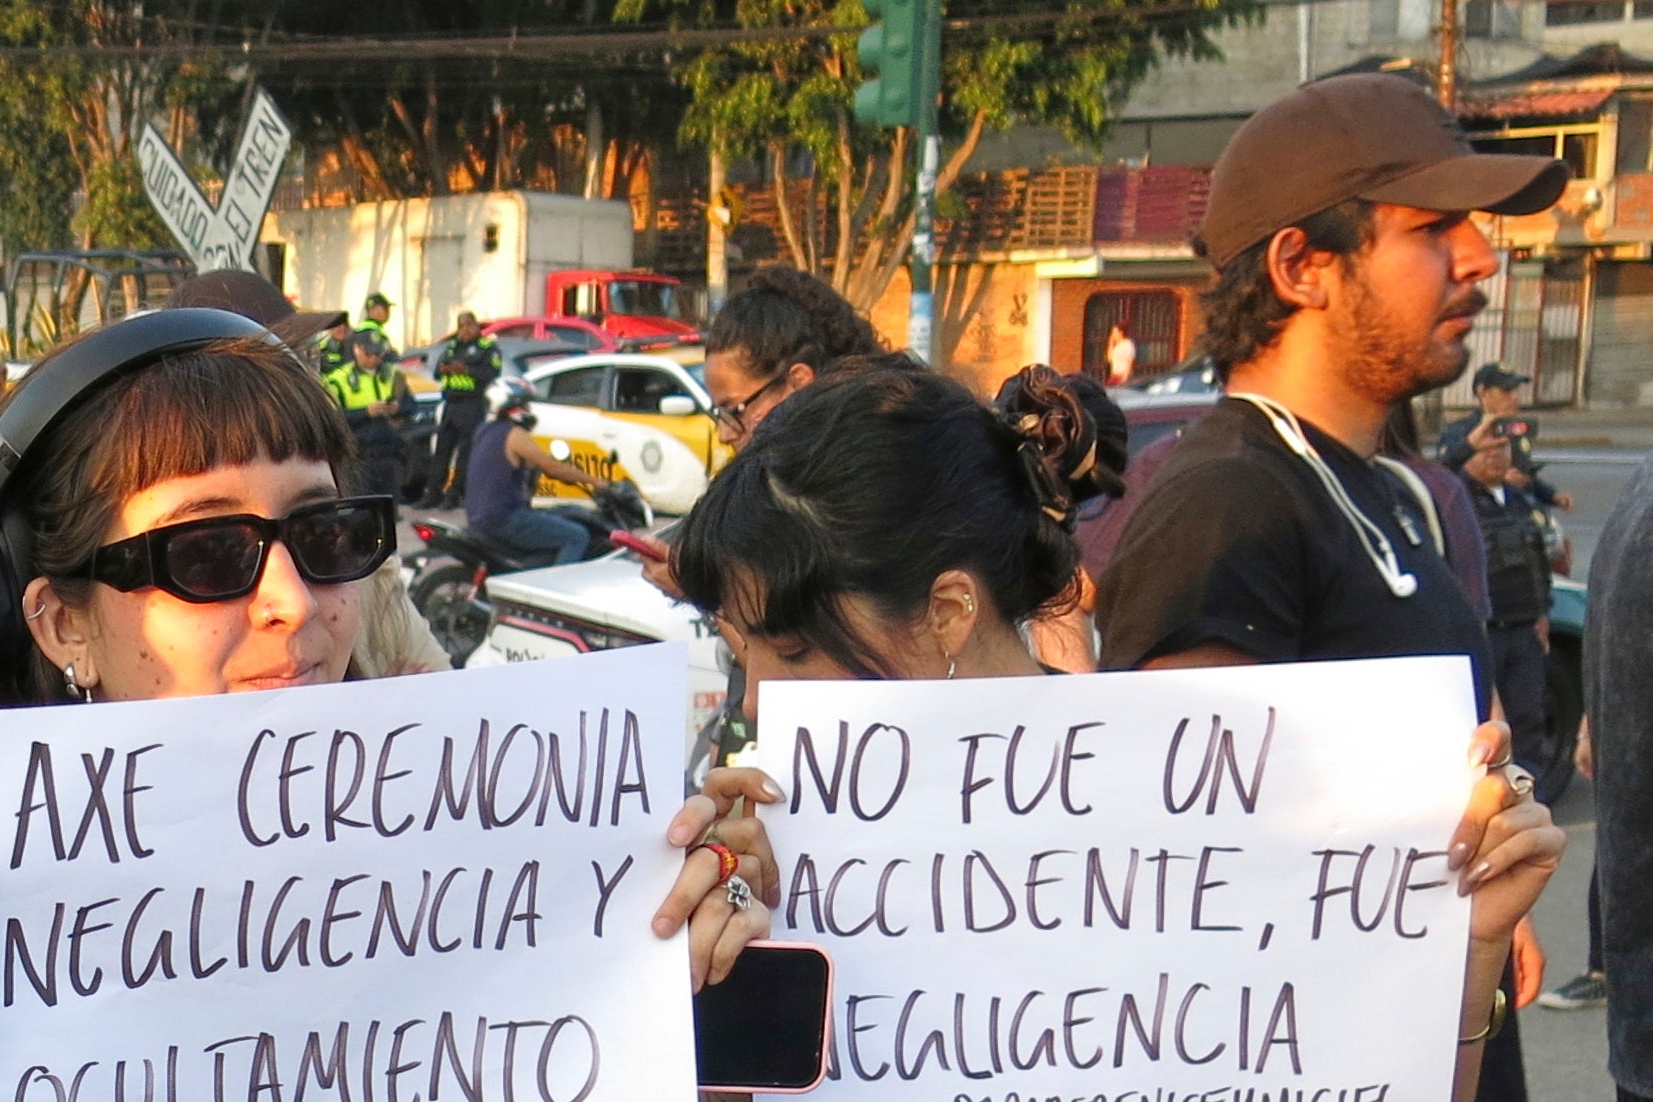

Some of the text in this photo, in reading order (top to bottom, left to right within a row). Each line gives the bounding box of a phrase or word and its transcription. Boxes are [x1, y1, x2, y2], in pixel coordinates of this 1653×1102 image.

[142, 137, 209, 250] CUIDADO
[237, 106, 284, 198] TREN
[9, 707, 651, 870] AXE CEREMONIA
[789, 705, 1277, 825] NO FUE UN
[3, 855, 635, 1007] NEGLIGENCIA Y
[784, 843, 1451, 951] ACCIDENTE, FUE
[825, 972, 1303, 1082] EGLIGENCIA
